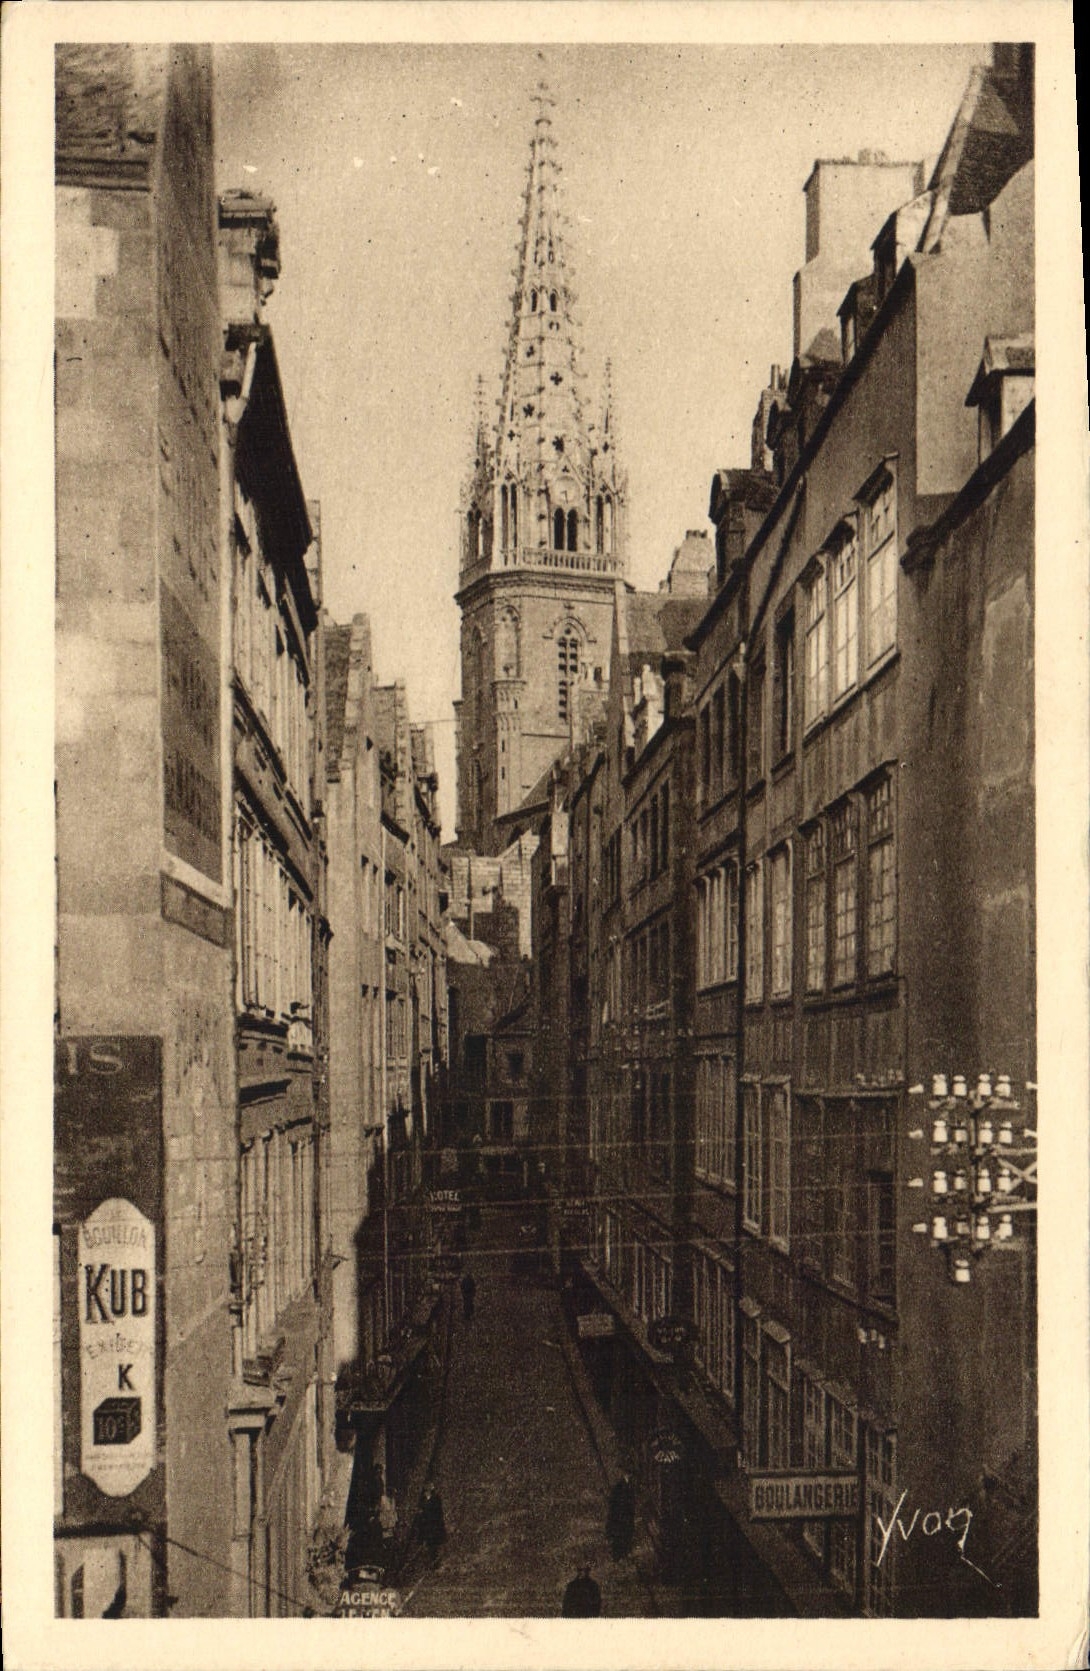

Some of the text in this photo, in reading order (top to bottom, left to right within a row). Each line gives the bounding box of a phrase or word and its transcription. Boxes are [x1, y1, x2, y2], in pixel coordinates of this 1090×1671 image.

[85, 1263, 149, 1323] KUB
[117, 1363, 135, 1391] K
[755, 1483, 858, 1510] BOULANGERIE
[340, 1591, 396, 1606] AGENCE
